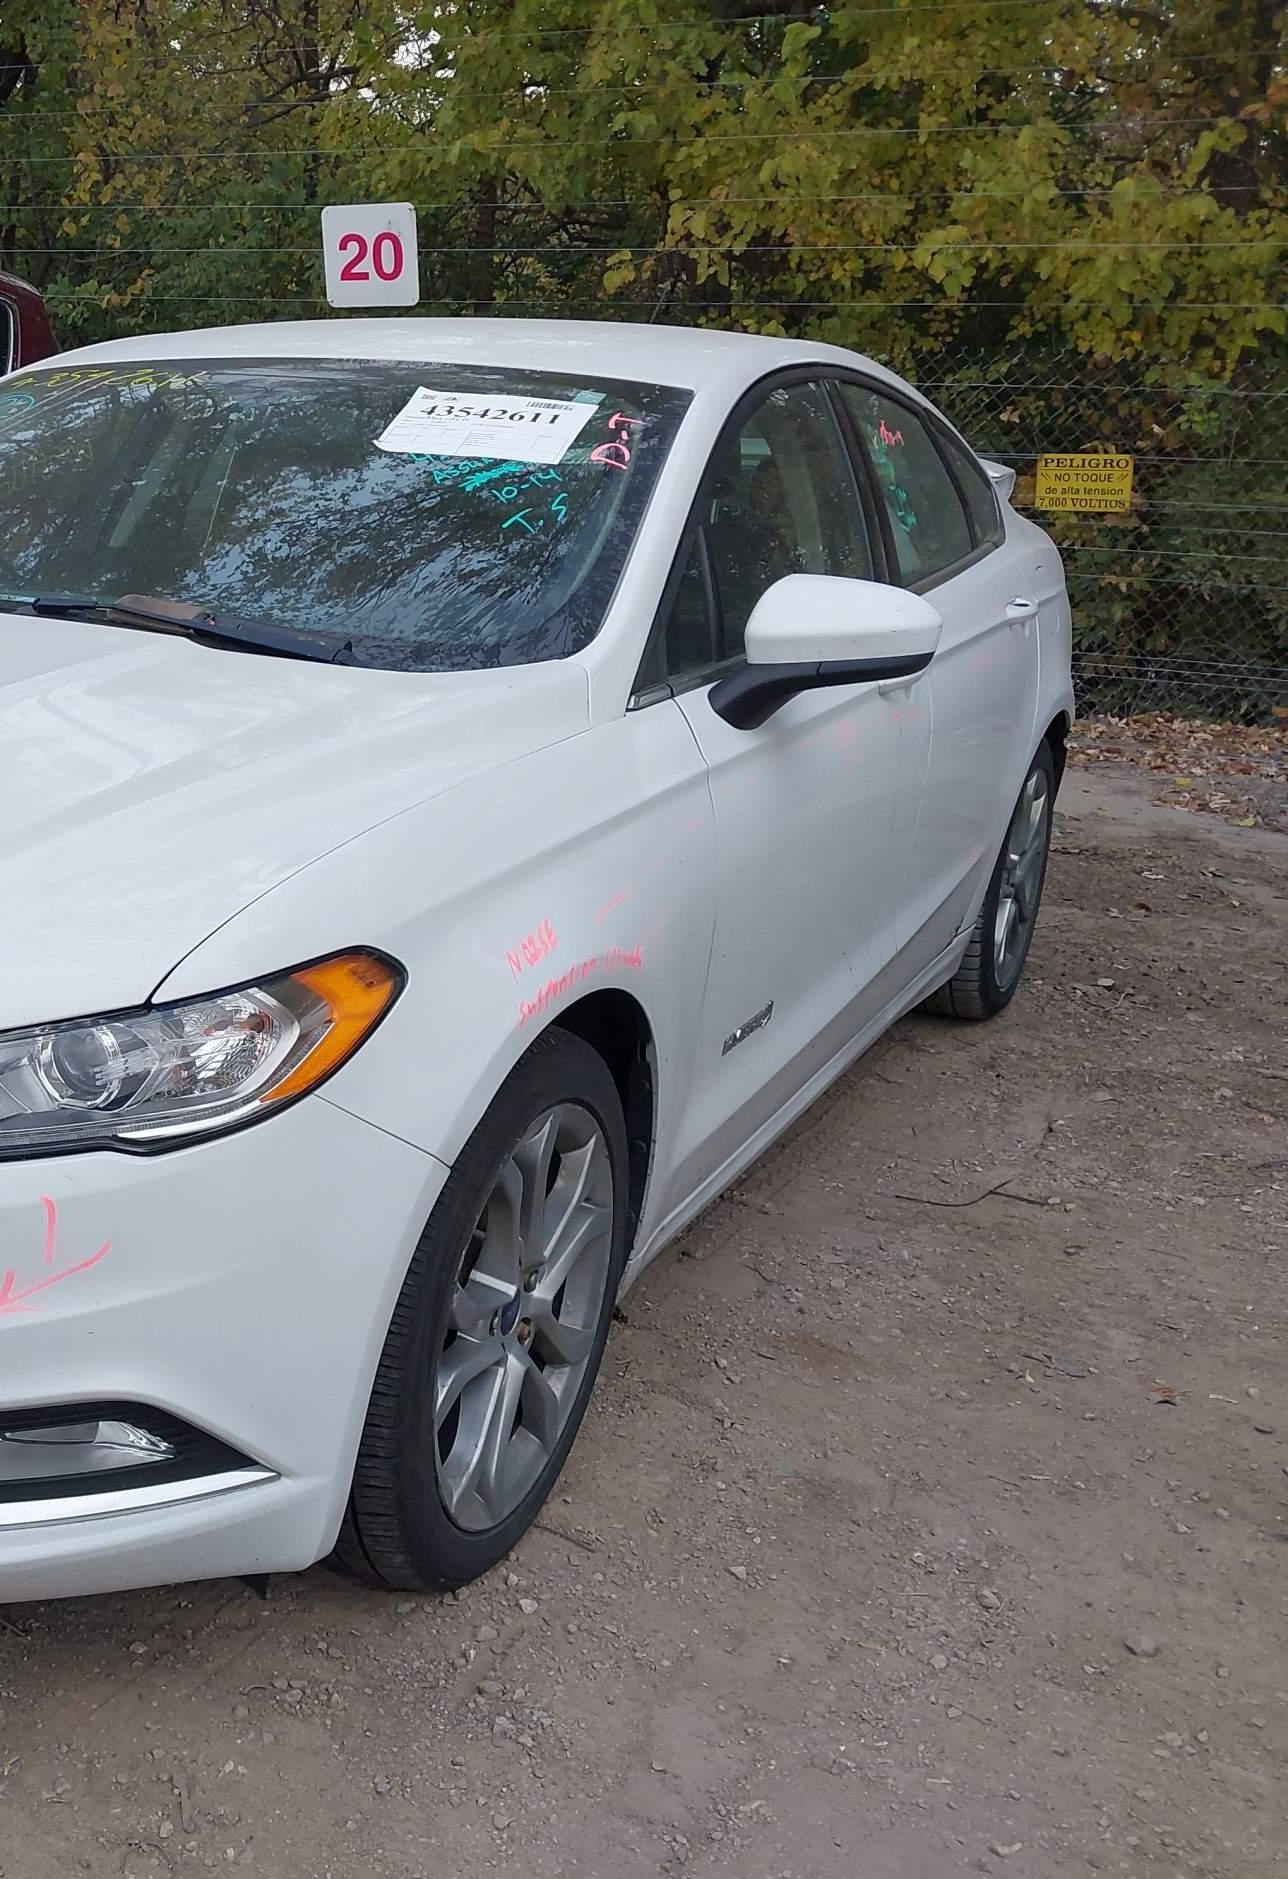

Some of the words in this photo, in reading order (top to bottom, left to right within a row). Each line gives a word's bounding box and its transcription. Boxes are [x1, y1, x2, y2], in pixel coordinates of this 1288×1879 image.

[337, 231, 405, 282] 20
[420, 404, 561, 425] 43542611
[1042, 458, 1130, 469] PELIGRO
[1054, 473, 1071, 482] NO
[1075, 472, 1114, 482] TOQUE
[1045, 486, 1058, 495] de
[1061, 486, 1080, 495] alta
[1083, 486, 1124, 496] tension
[1040, 498, 1067, 508] 7,000
[1070, 498, 1126, 509] VOLTIOS
